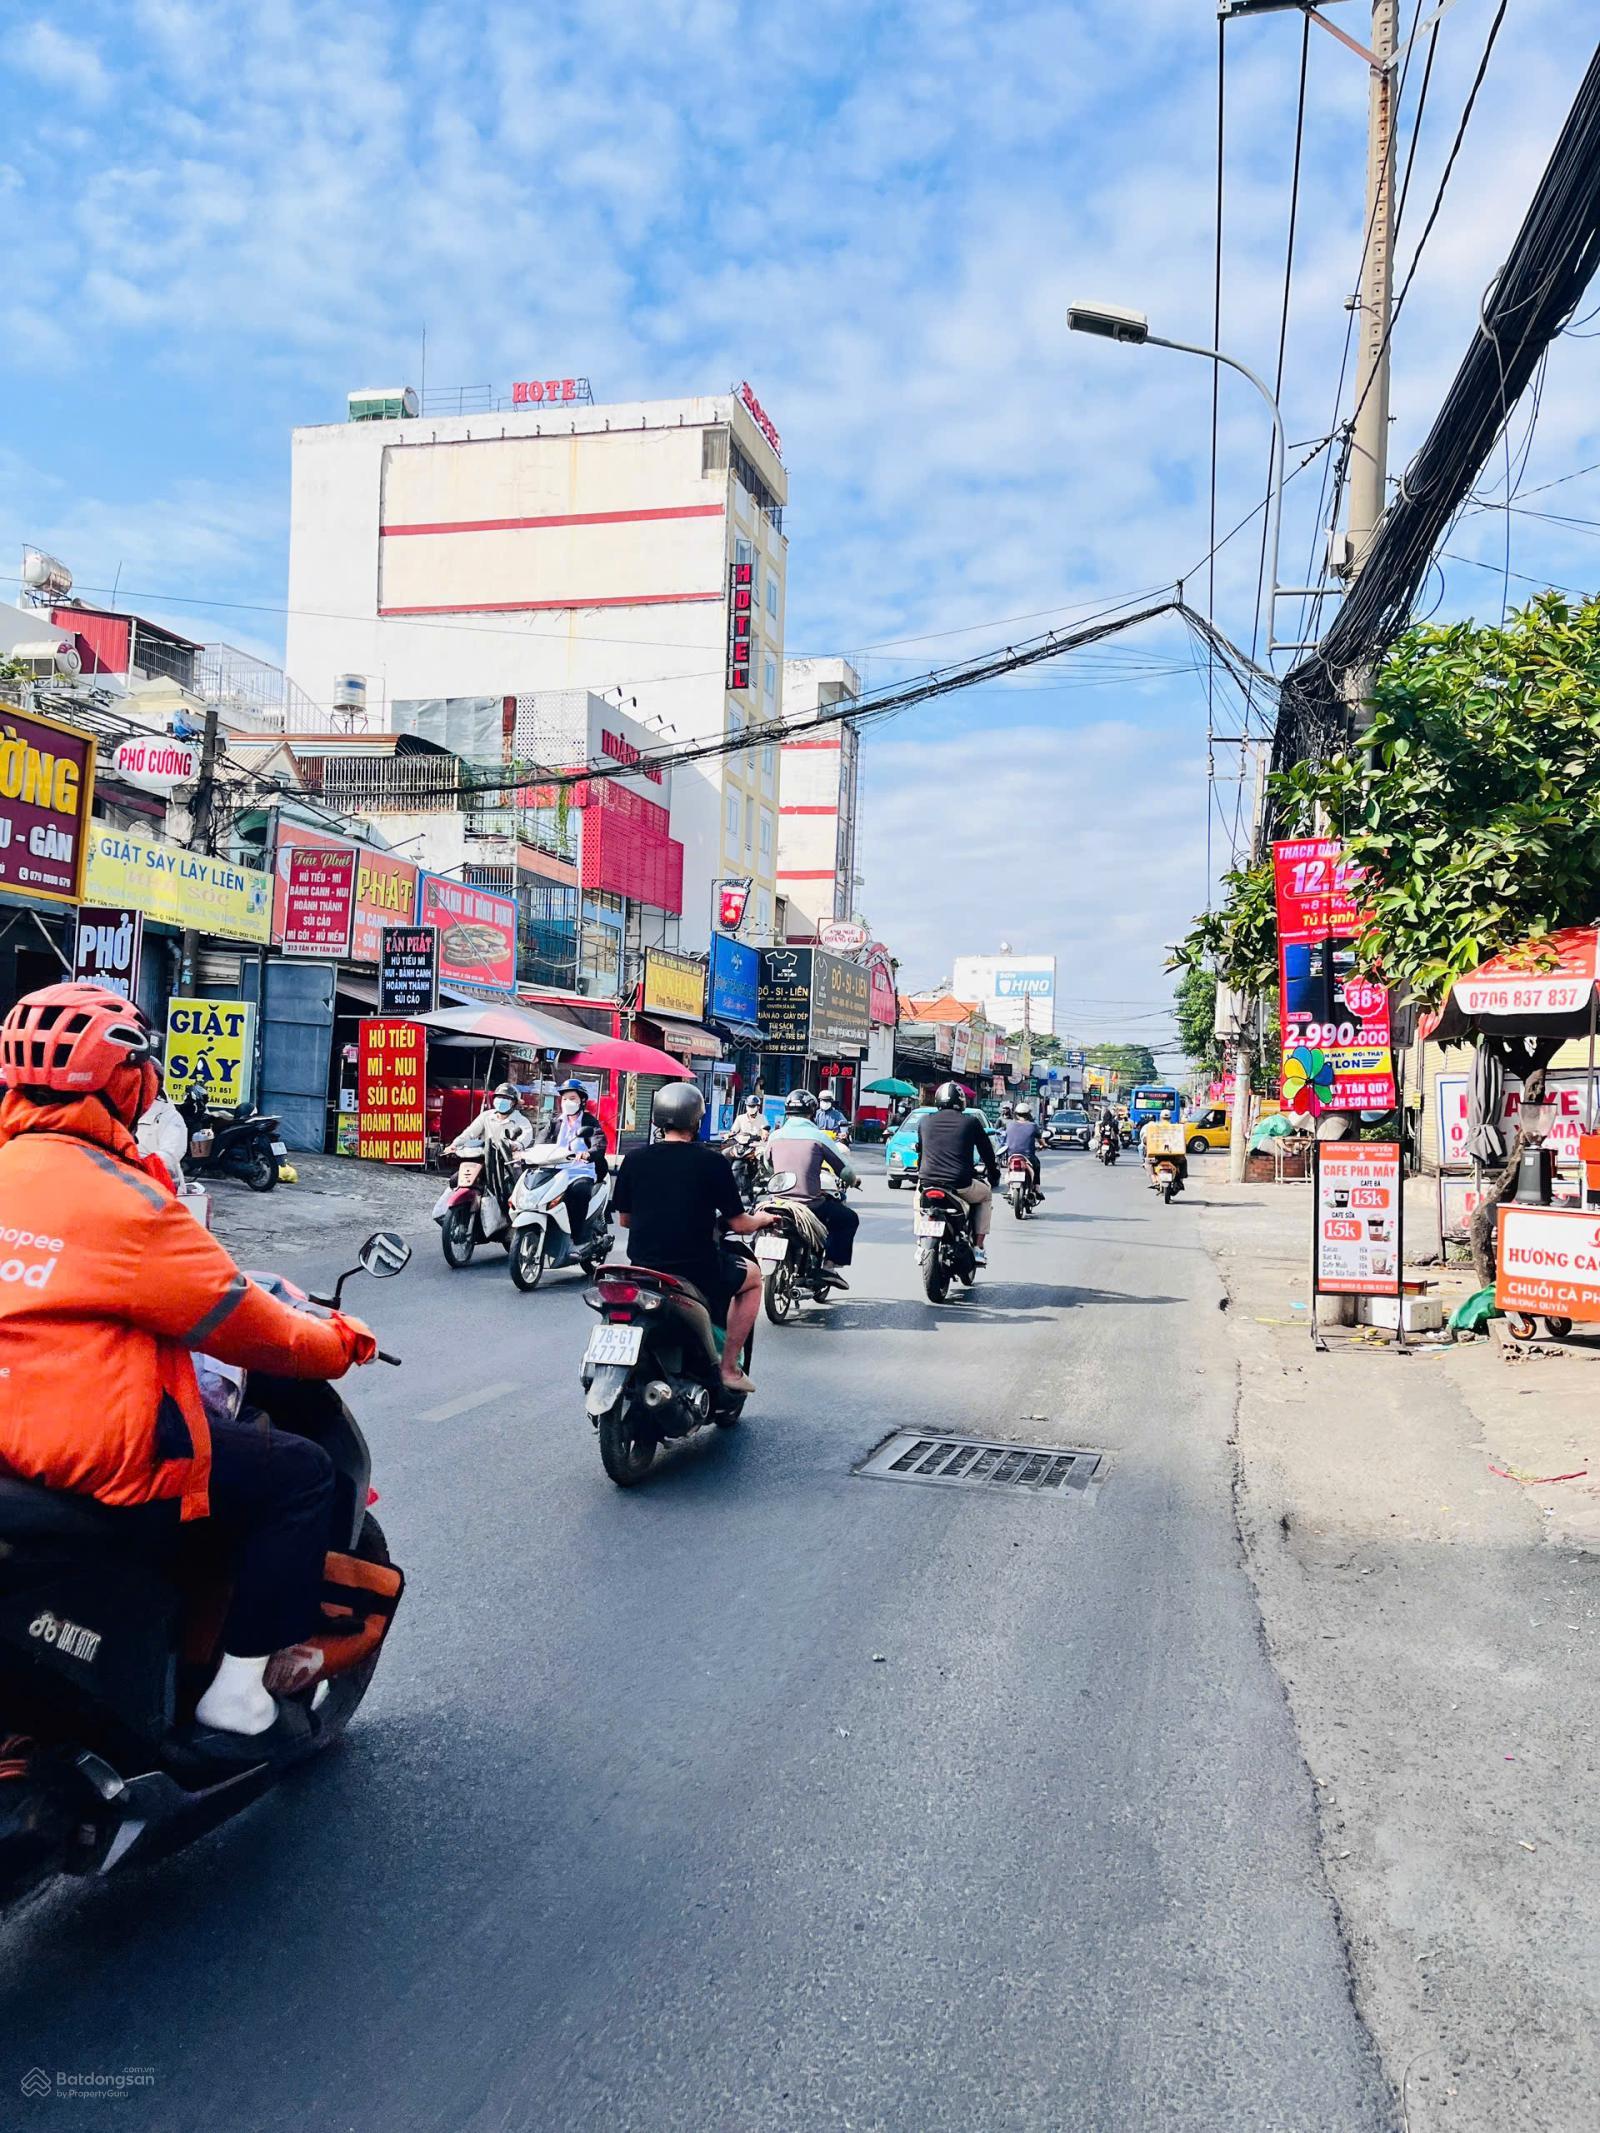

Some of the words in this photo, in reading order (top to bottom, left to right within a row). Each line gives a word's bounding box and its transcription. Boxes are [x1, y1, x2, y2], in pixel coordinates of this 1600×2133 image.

[735, 564, 751, 689] HOTEL
[0, 725, 79, 815] ỜNG
[119, 741, 146, 771] PHỞ
[149, 744, 192, 776] CƯỜNG
[358, 867, 413, 913] PHÁT
[1302, 913, 1318, 926] Tủ
[1322, 911, 1355, 927] Lạnh
[78, 912, 134, 970] PHỞ
[407, 932, 432, 953] PHÁT
[1514, 990, 1542, 1007] 837
[1548, 988, 1578, 1006] 837
[170, 1004, 245, 1042] GIẶT
[369, 1023, 386, 1048] HỦ
[389, 1023, 416, 1048] TIẾU
[169, 1046, 240, 1082] SẤY
[367, 1054, 383, 1076] MÌ
[395, 1057, 417, 1076] NUI
[367, 1080, 388, 1105] SỦI
[391, 1080, 416, 1105] CẢO
[1345, 1082, 1365, 1094] TÂN
[360, 1110, 391, 1132] HOÀNH
[393, 1110, 422, 1132] THÁNH
[360, 1137, 390, 1159] BÁNH
[392, 1139, 423, 1160] CANH
[1324, 1165, 1347, 1176] CAFE
[1351, 1165, 1370, 1177] PHA
[1373, 1163, 1396, 1177] MÁY
[1353, 1190, 1383, 1206] 13k
[1326, 1222, 1355, 1237] 15k
[1508, 1247, 1569, 1268] HƯƠNG
[1574, 1254, 1600, 1271] CA
